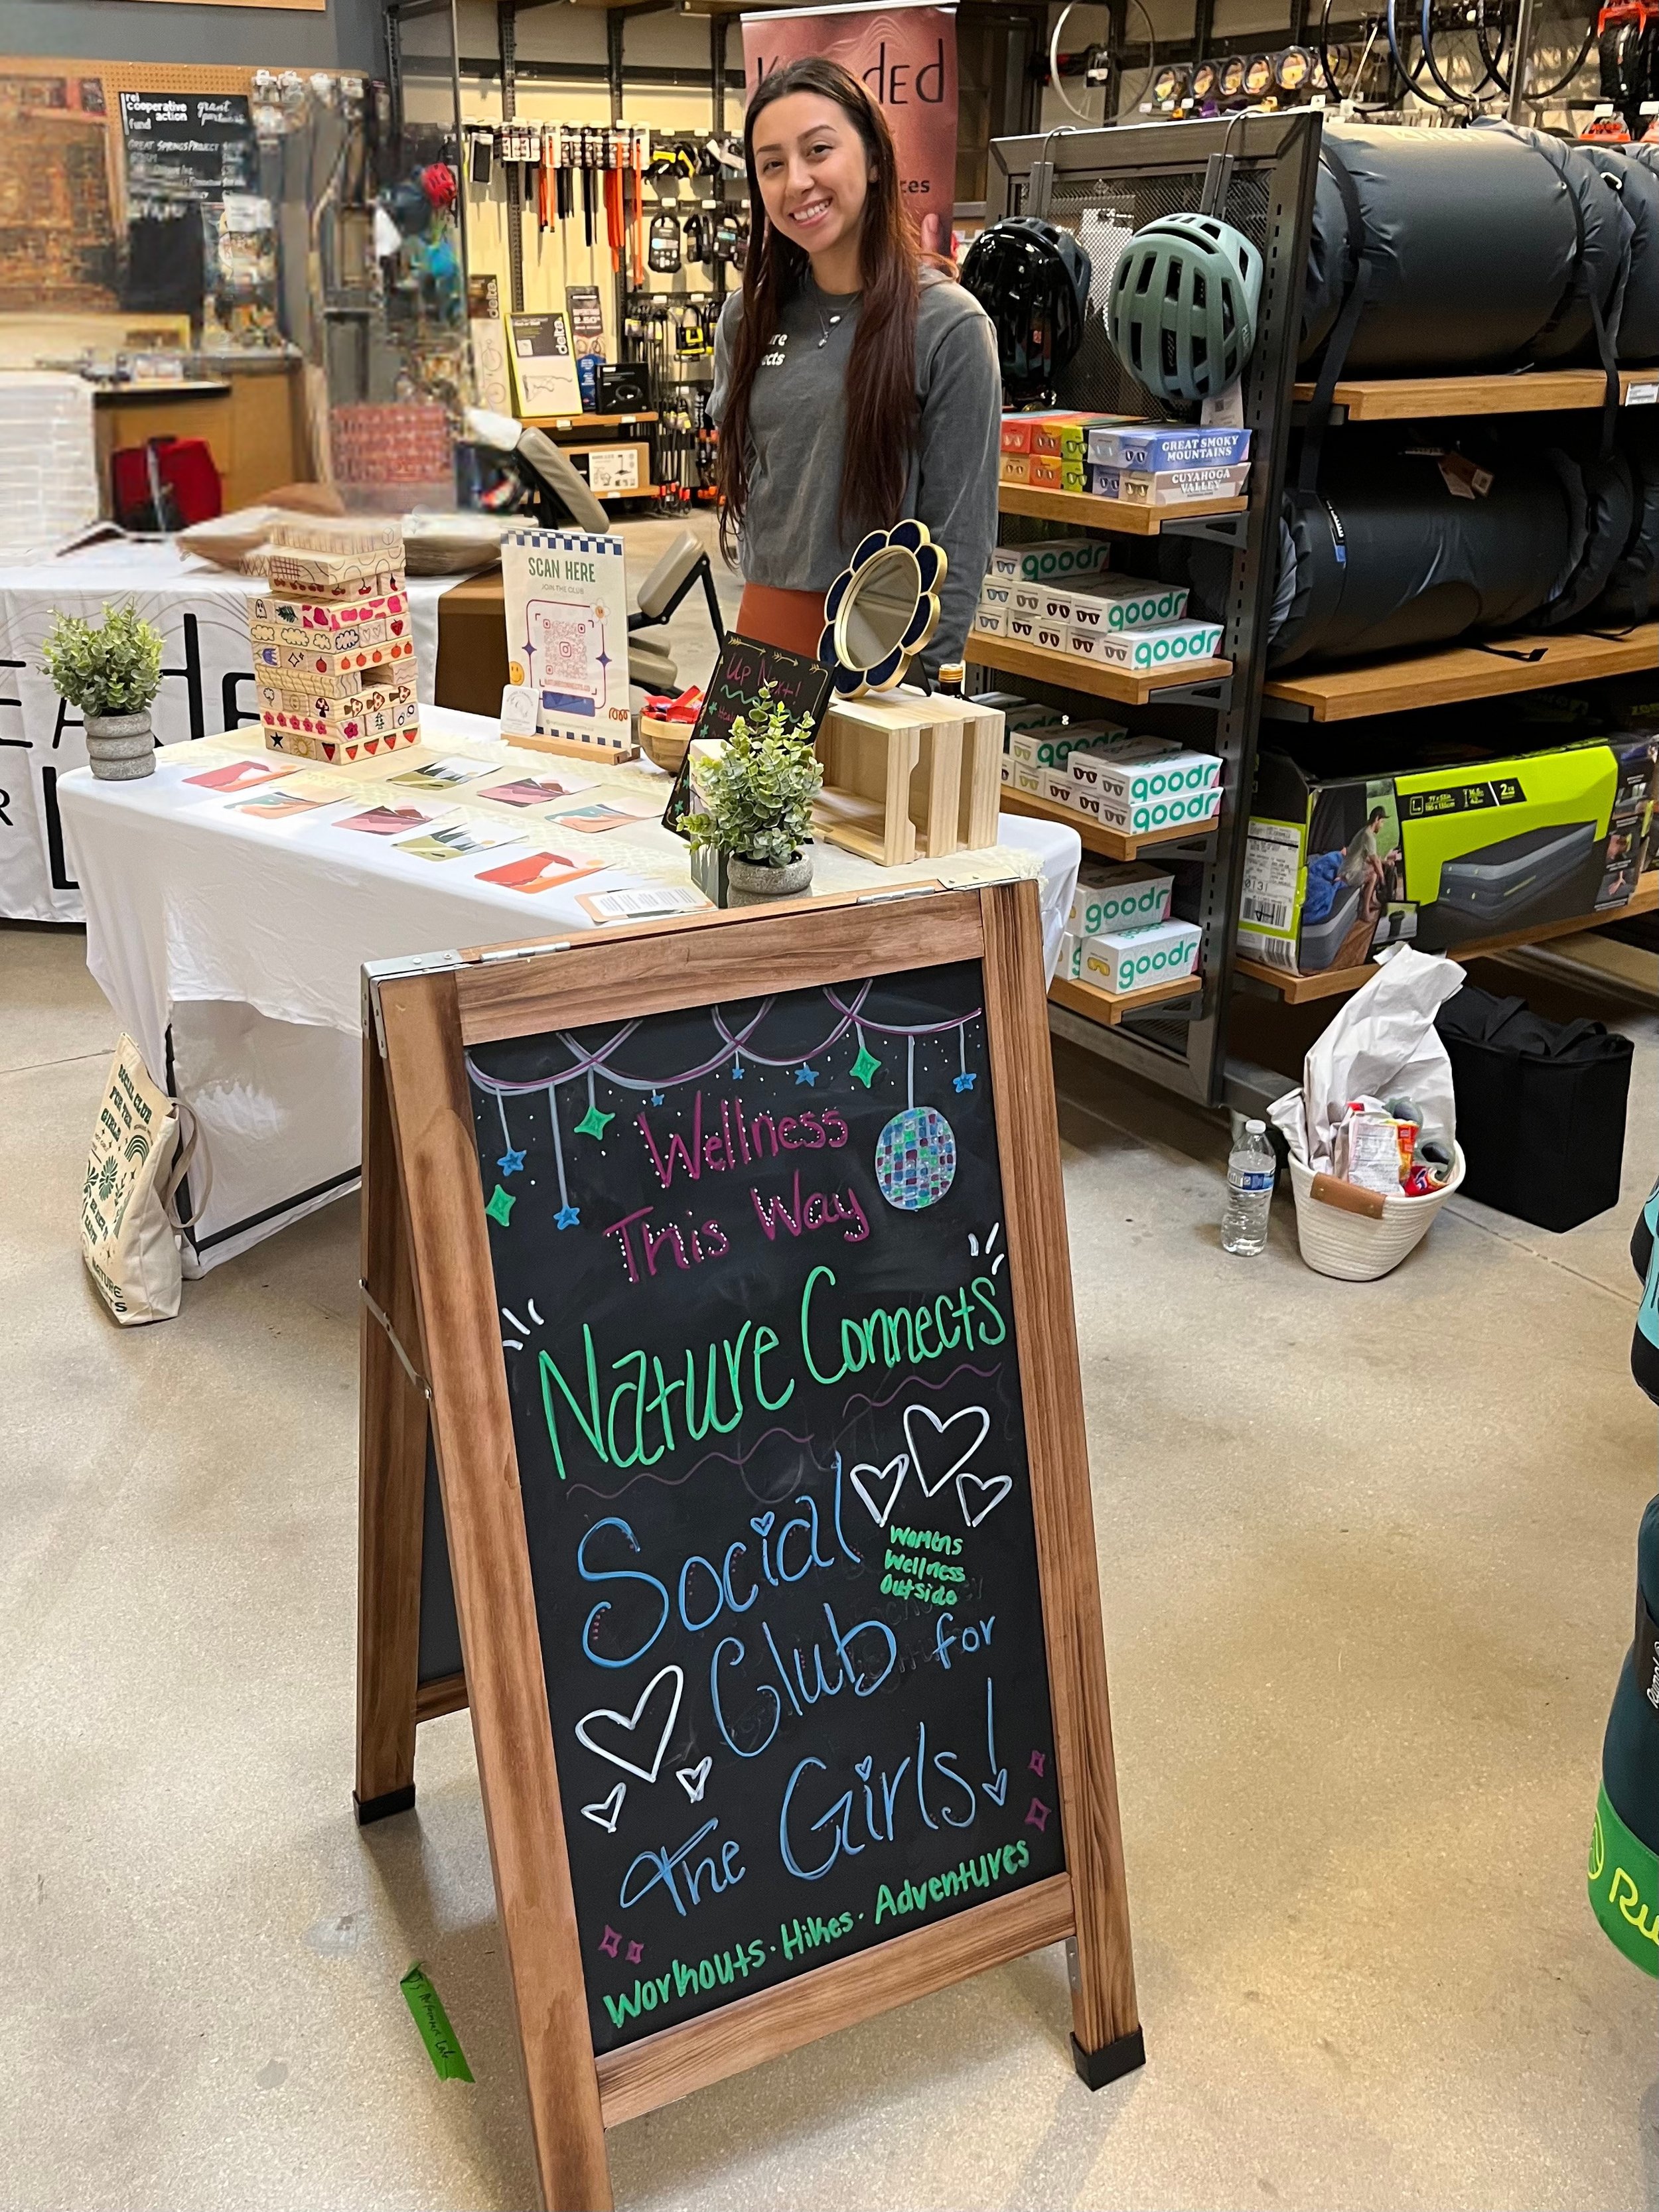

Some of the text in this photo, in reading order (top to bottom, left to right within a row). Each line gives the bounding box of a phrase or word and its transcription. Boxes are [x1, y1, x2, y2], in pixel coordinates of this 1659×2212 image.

[126, 100, 187, 113] cooperative
[155, 111, 188, 121] action
[1162, 435, 1239, 451] GREAT SMOKY
[1167, 447, 1232, 462] MOUNTAINS
[1172, 468, 1230, 484] CUYAHOGA
[1181, 480, 1222, 494] VALLEY
[528, 557, 596, 583] SCAN HERE
[1021, 545, 1107, 580] goodr
[1108, 592, 1187, 632] goodr
[1135, 630, 1222, 669] goodr
[726, 653, 802, 706] Up Nxt!
[1131, 763, 1218, 803] goodr
[1133, 792, 1220, 835] goodr
[1085, 886, 1170, 933] goodr
[1118, 940, 1198, 989] goodr
[634, 1091, 848, 1188] Wellness
[603, 1170, 869, 1283] This Way
[539, 1266, 1007, 1480] Nature Connects
[577, 1451, 862, 1669] Social
[885, 1549, 966, 1582] Wellness
[711, 1603, 995, 1757] Club for
[779, 1678, 1007, 1880] Girls!
[875, 1839, 1030, 1925] Adventures
